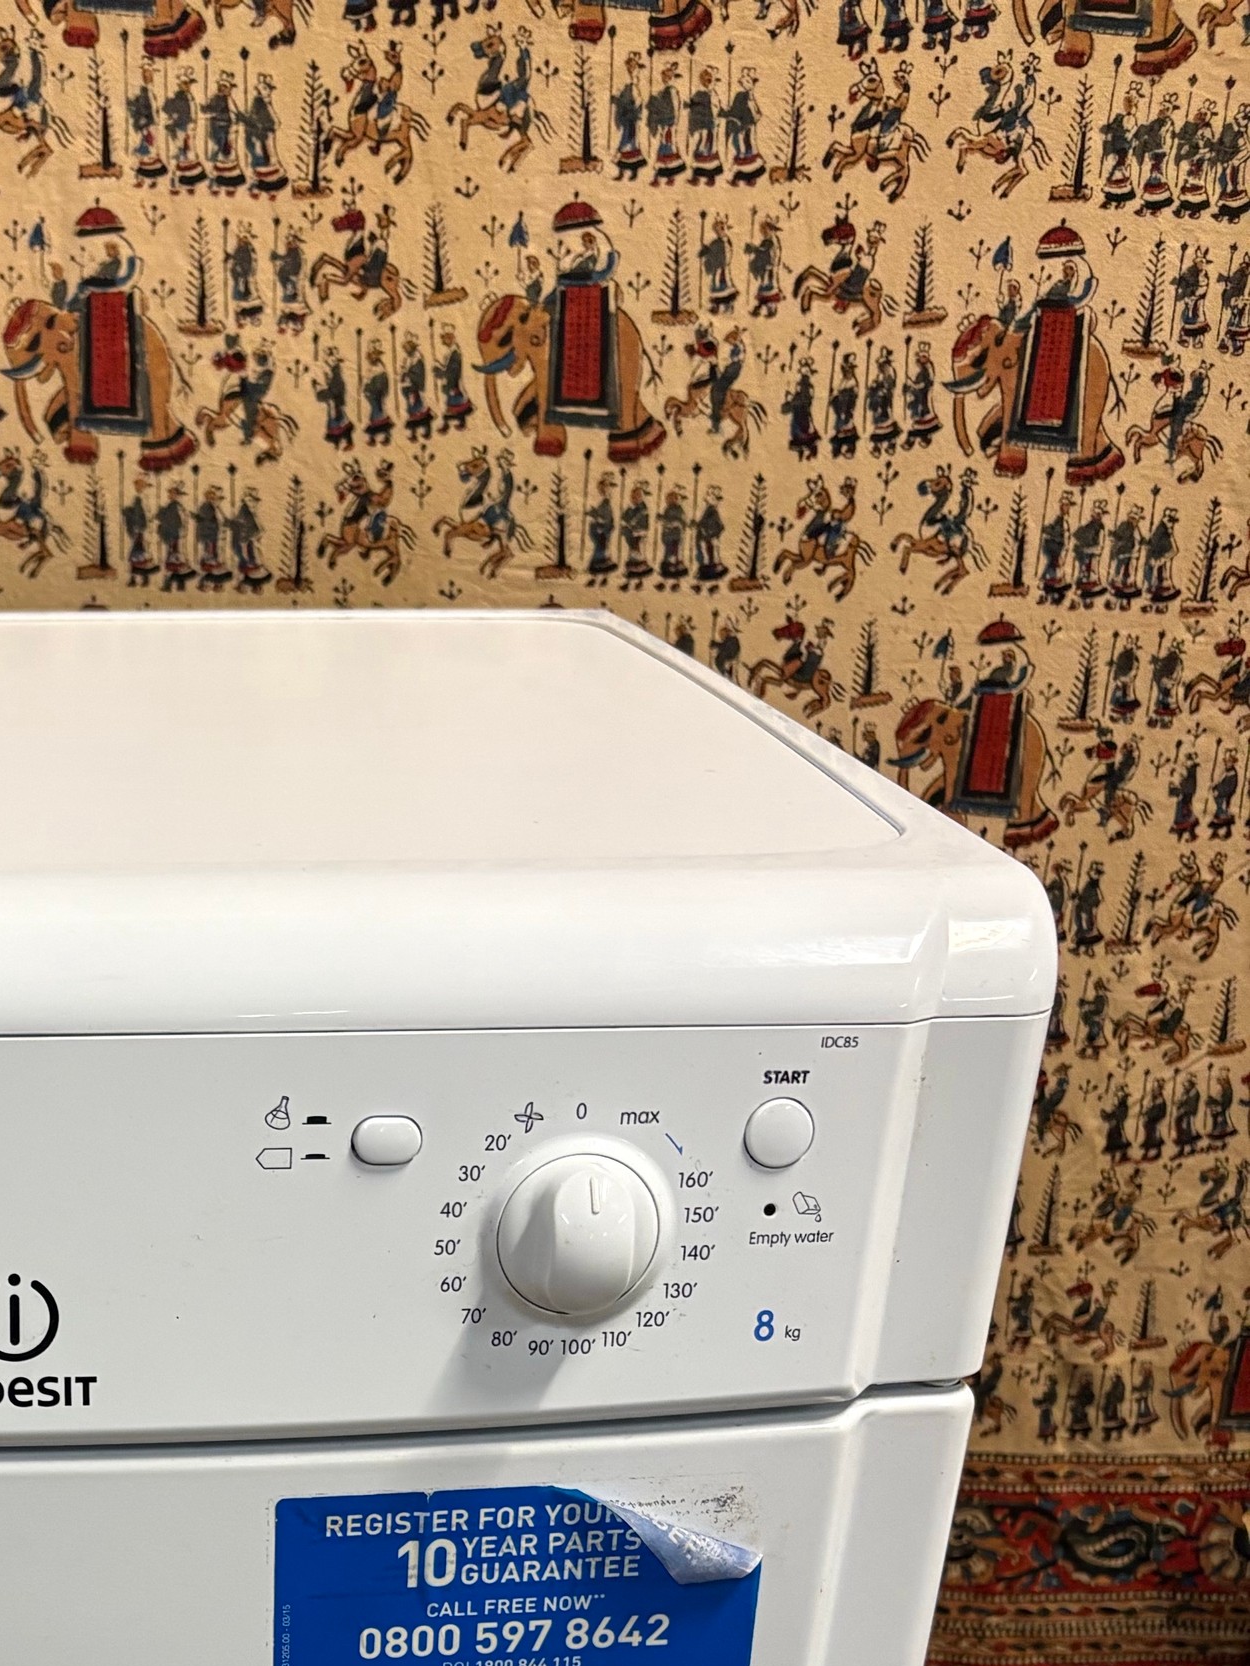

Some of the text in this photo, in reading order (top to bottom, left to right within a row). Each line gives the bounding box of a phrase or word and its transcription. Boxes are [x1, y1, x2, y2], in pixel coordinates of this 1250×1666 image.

[820, 1036, 860, 1049] IDC85
[762, 1070, 811, 1085] START
[576, 1102, 588, 1121] 0
[619, 1111, 661, 1126] max
[749, 1230, 834, 1248] Empty water
[754, 1310, 802, 1342] 8 kg
[326, 1509, 469, 1537] REGISTER
[479, 1505, 536, 1530] FOR
[397, 1538, 457, 1588] 10
[461, 1535, 538, 1559] YEAR
[549, 1528, 642, 1555] PARTS
[460, 1554, 641, 1586] GUARANTEE
[426, 1602, 478, 1618] CALL
[484, 1597, 537, 1615] FREE
[359, 1613, 670, 1660] 0800 597 8642
